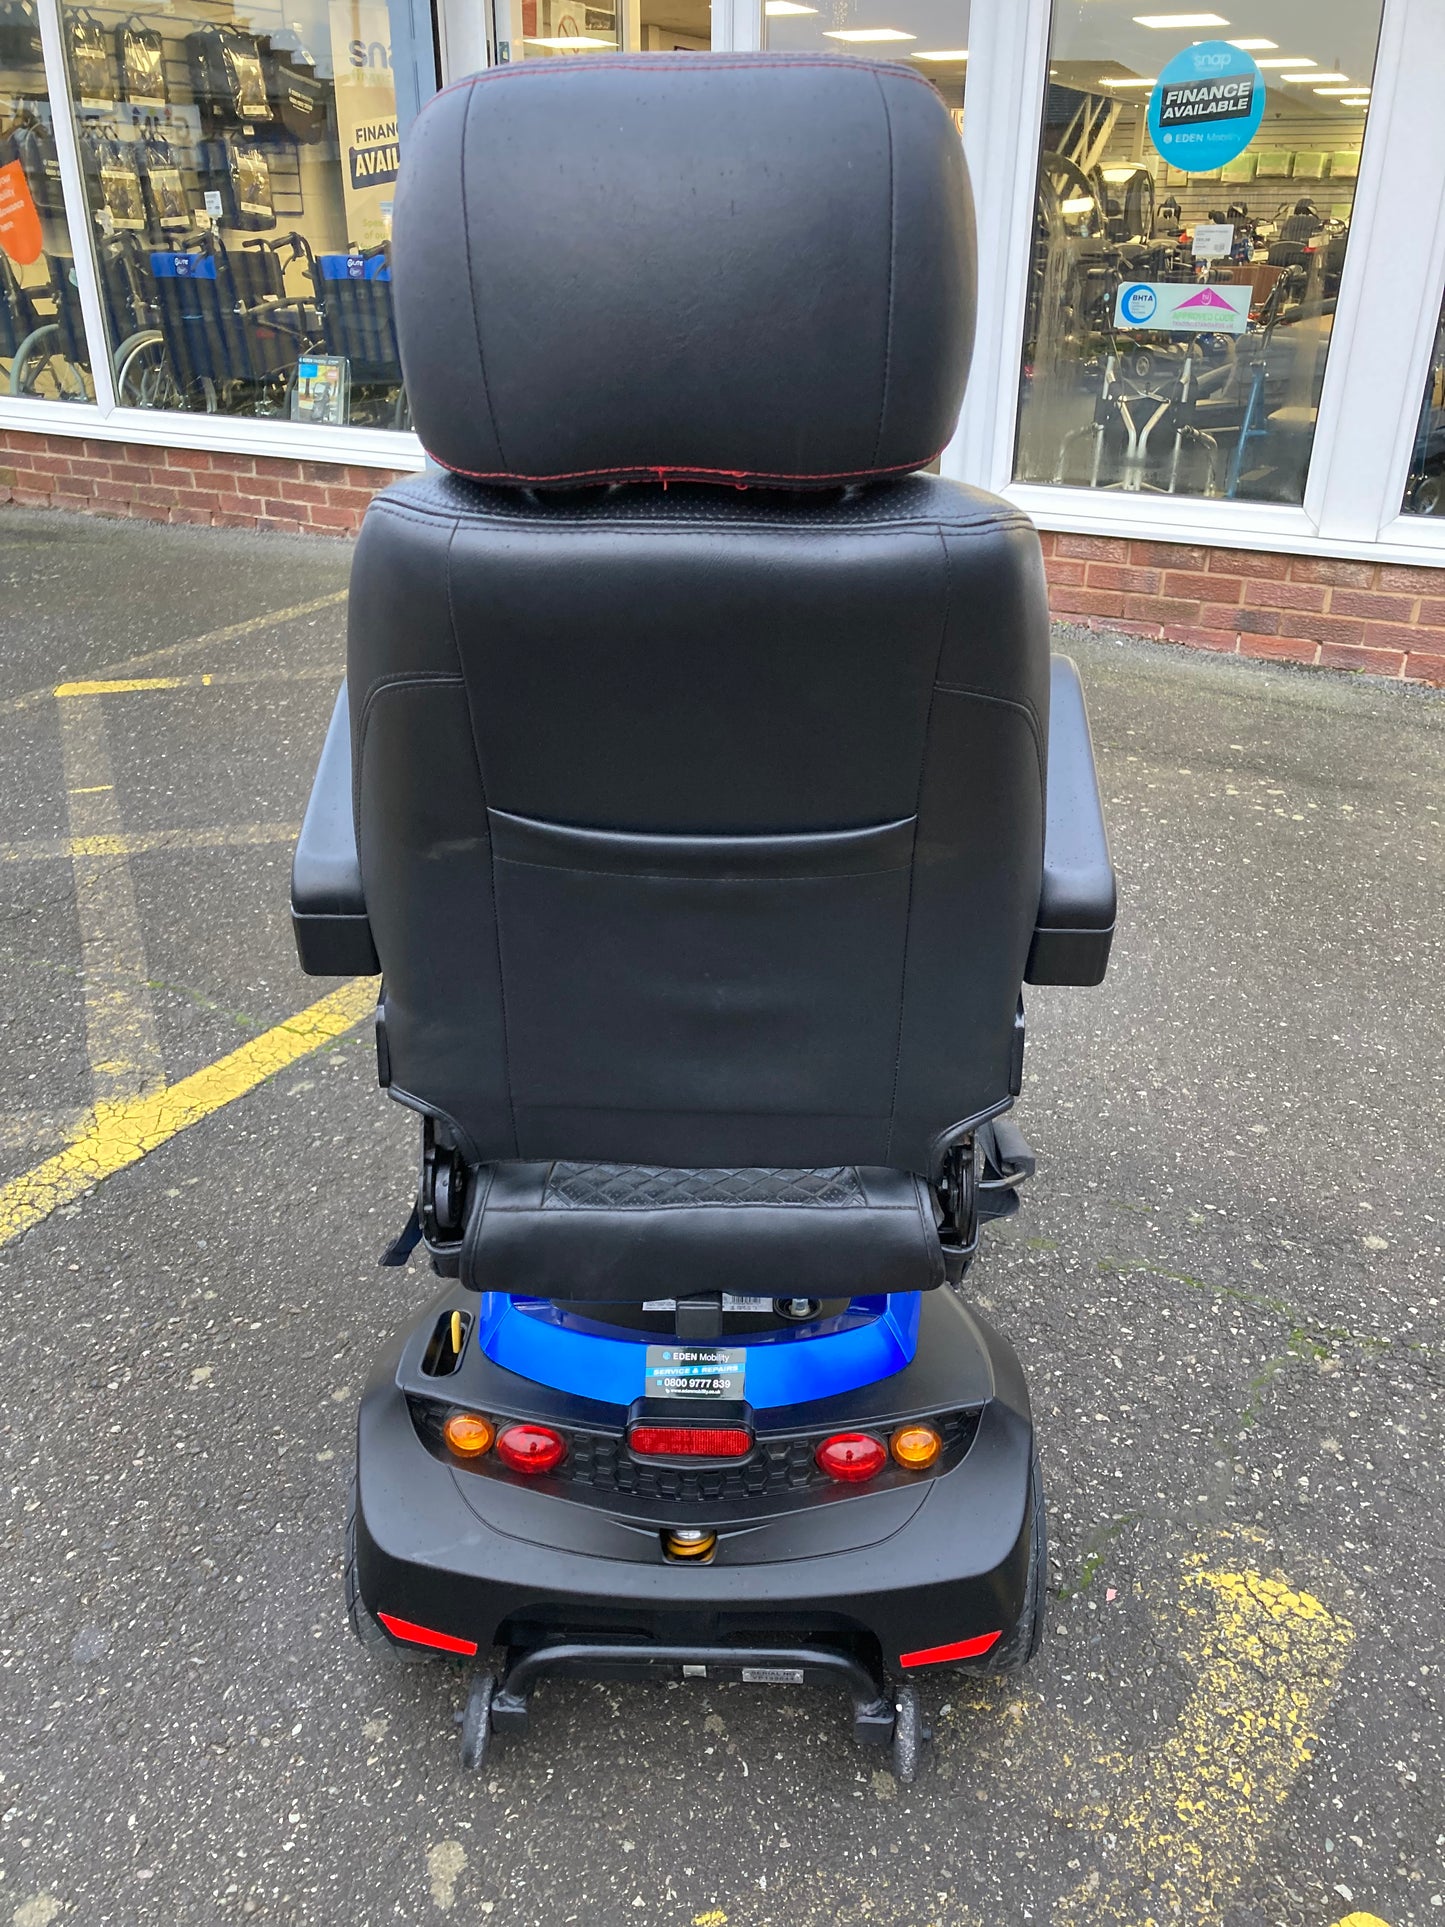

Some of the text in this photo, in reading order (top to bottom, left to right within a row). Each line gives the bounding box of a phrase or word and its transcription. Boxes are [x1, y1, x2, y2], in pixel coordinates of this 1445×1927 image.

[1194, 54, 1232, 71] snap
[1165, 82, 1251, 105] FINANCE
[1163, 98, 1249, 119] AVAILABLE
[1175, 133, 1204, 143] EDEN
[1132, 294, 1153, 302] BHTA
[1172, 312, 1236, 322] APPROVED CODE
[673, 1352, 730, 1363] EDEN Mobility
[653, 1365, 739, 1376] SERVICE & REPAIRS
[664, 1378, 731, 1388] 0800 9777 839
